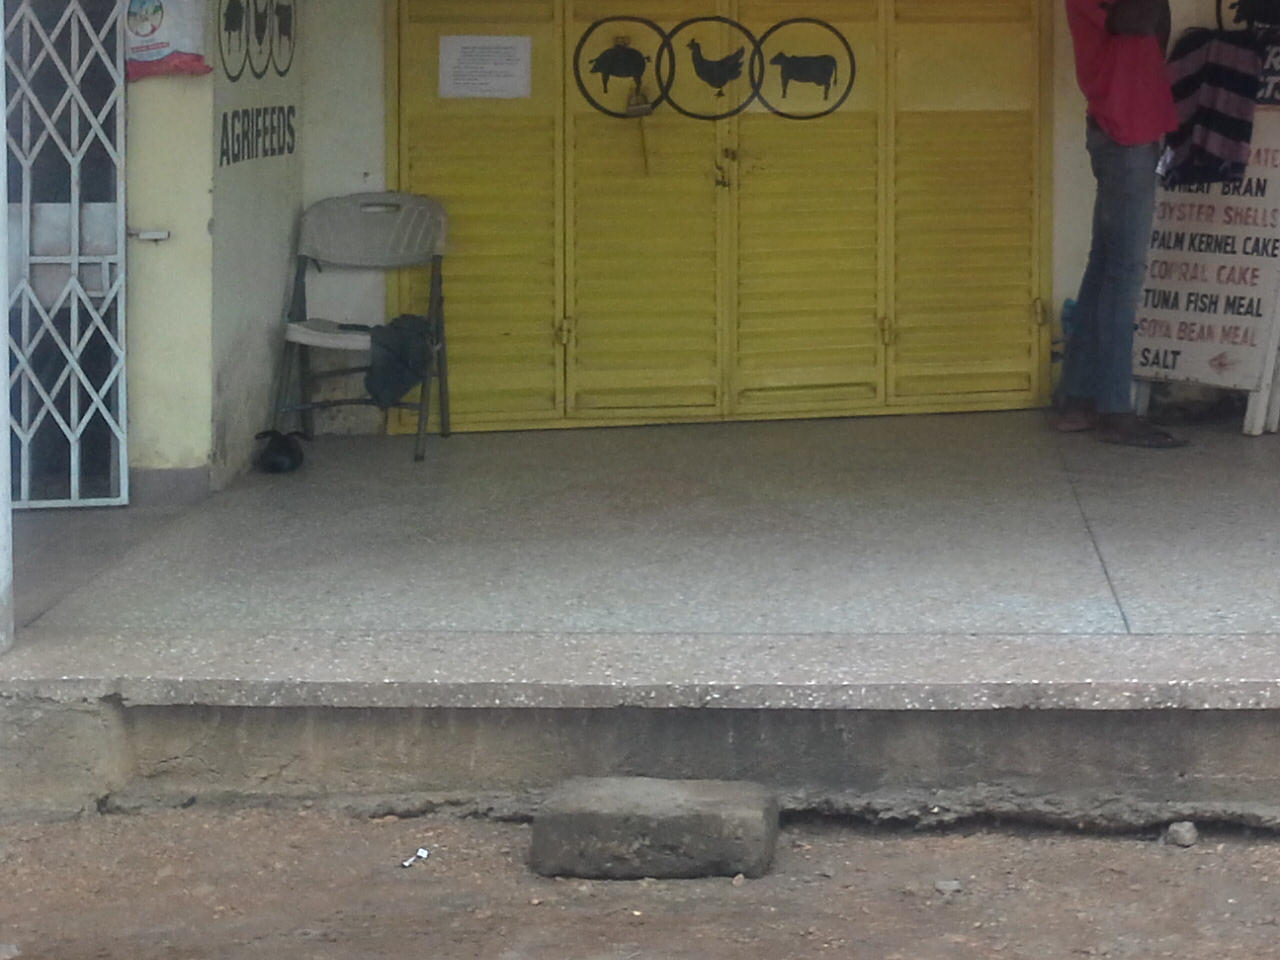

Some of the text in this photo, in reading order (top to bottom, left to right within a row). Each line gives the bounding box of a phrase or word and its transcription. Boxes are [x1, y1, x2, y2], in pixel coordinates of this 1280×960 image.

[219, 105, 296, 167] AGRIFEEDS
[1221, 177, 1267, 197] BRAN
[1157, 202, 1278, 228] OYSTER SHELLS
[1151, 230, 1280, 258] PALM KERNEL CAKE
[1216, 265, 1260, 286] CAKE
[1143, 289, 1263, 318] TUNA FISH MEAL
[1176, 321, 1215, 342] BEAN
[1220, 325, 1258, 348] MEAL
[1139, 347, 1181, 370] SALT
